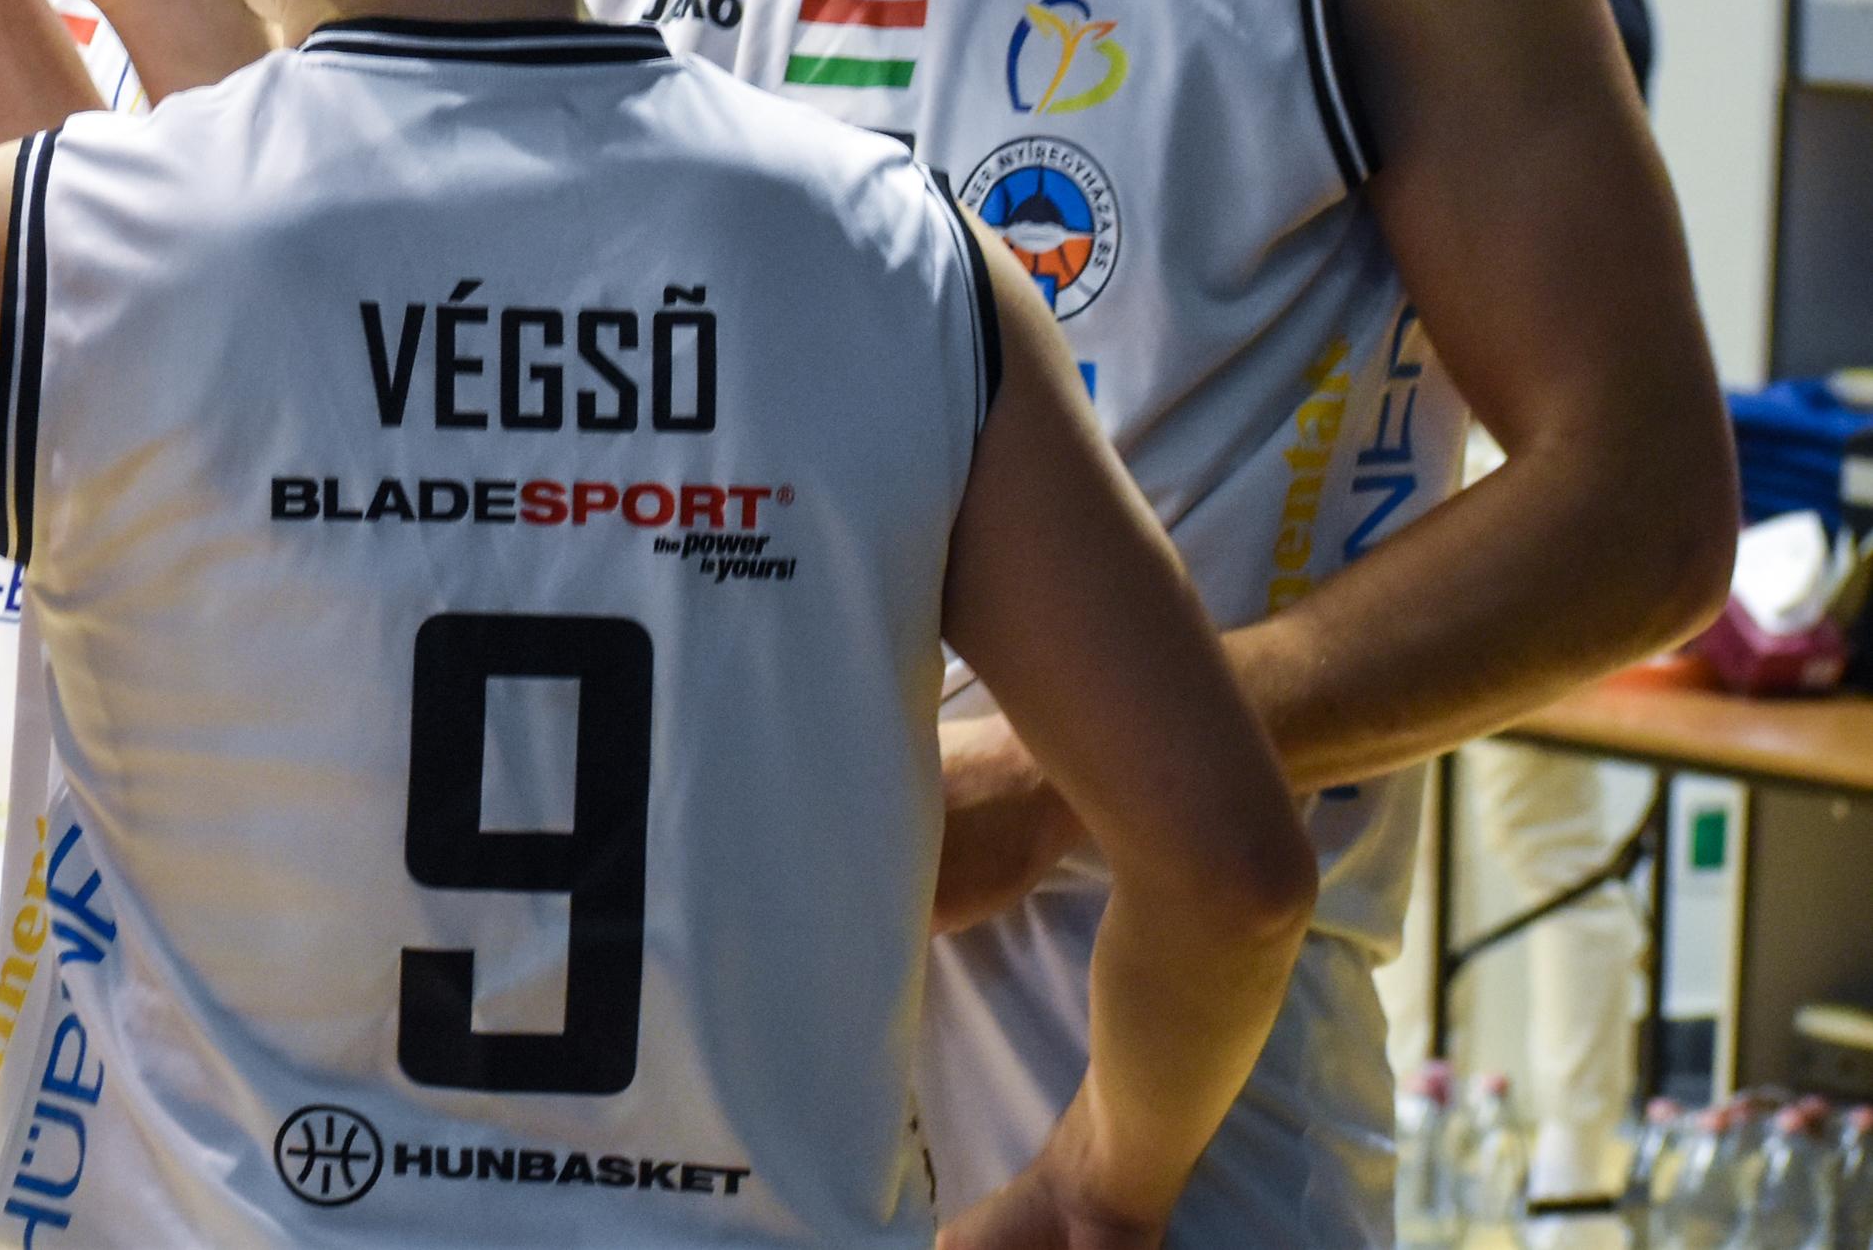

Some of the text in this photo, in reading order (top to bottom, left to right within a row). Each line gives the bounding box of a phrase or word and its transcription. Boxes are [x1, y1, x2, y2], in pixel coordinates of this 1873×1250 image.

[360, 279, 718, 433] VÉGSÕ
[681, 533, 770, 560] power
[714, 557, 797, 585] yours!
[397, 611, 654, 1096] 9
[392, 1142, 752, 1195] HUNBASKET
